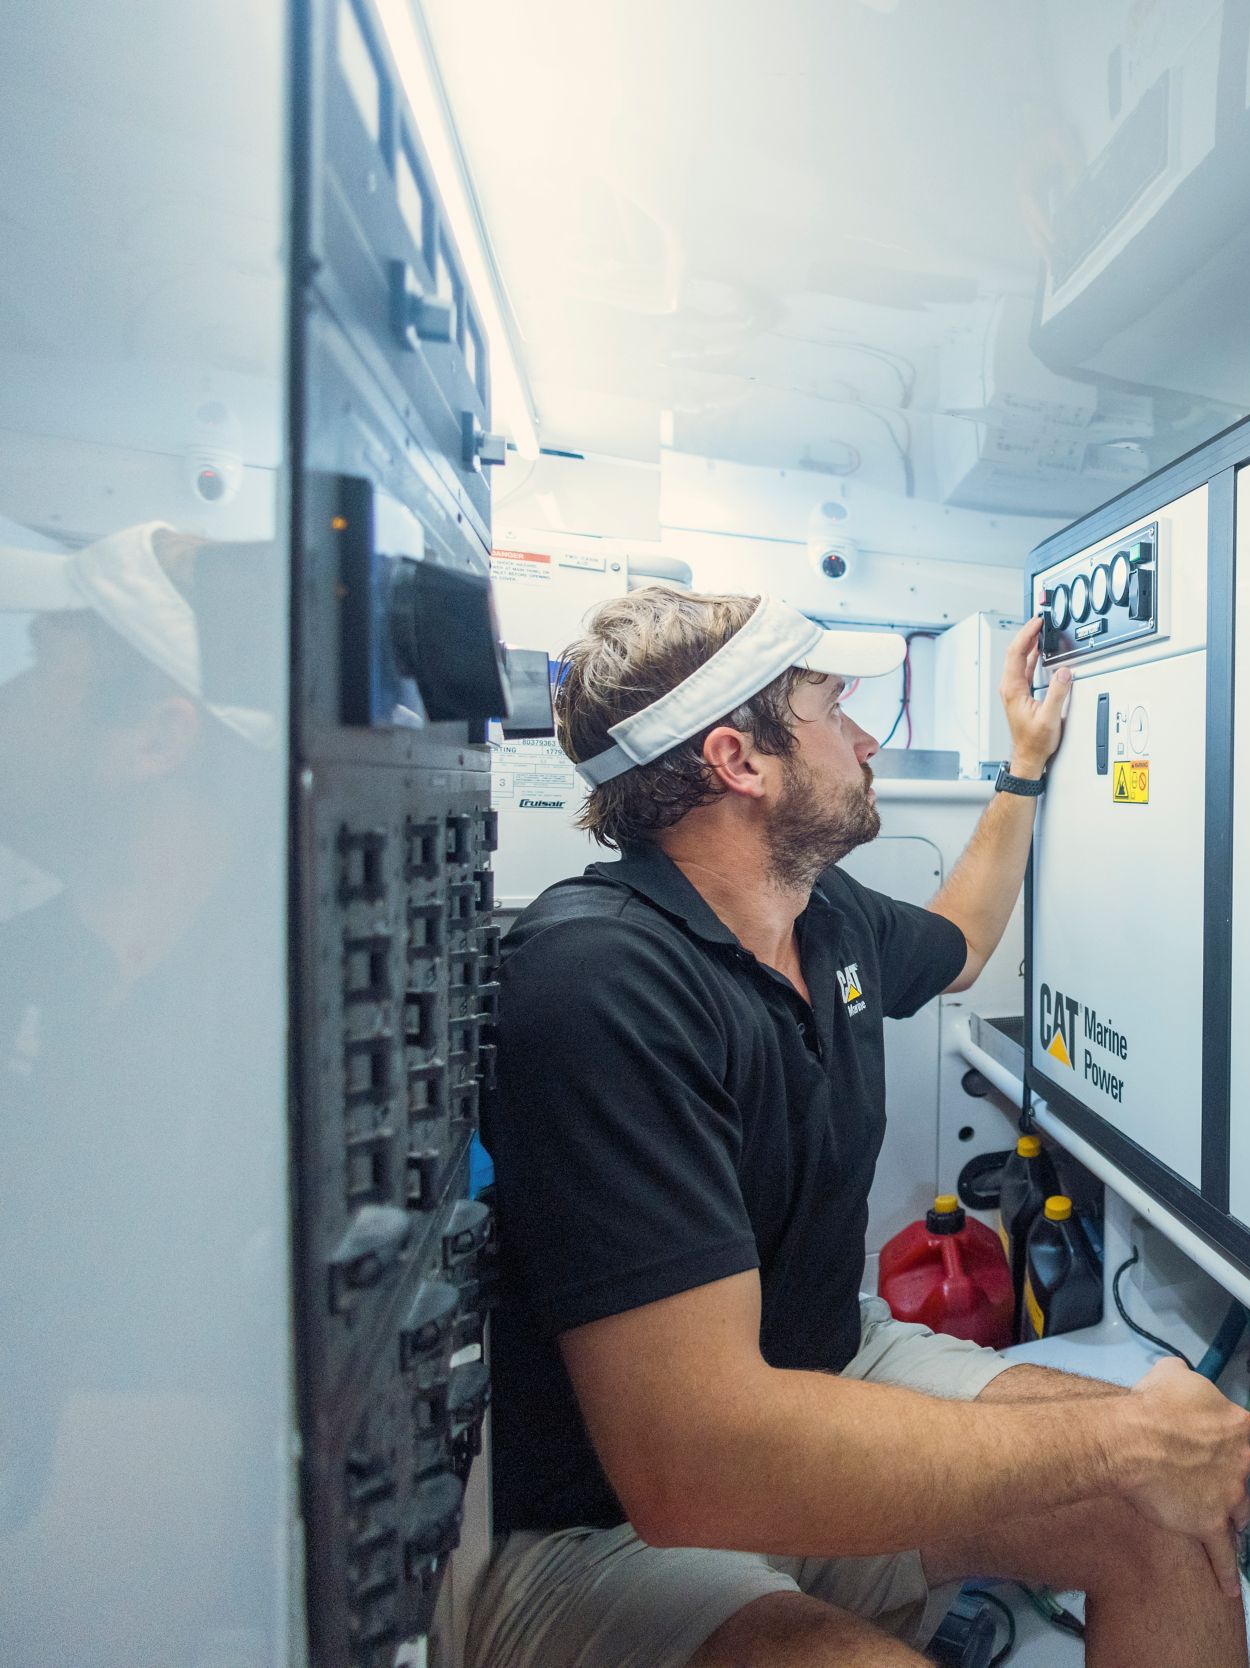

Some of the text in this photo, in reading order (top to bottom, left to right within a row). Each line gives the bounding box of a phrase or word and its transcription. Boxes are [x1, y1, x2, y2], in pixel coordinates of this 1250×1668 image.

[499, 778, 506, 787] 3
[836, 963, 863, 1004] CAT
[1040, 983, 1128, 1071] CAT Marine
[1084, 1048, 1124, 1103] Power
